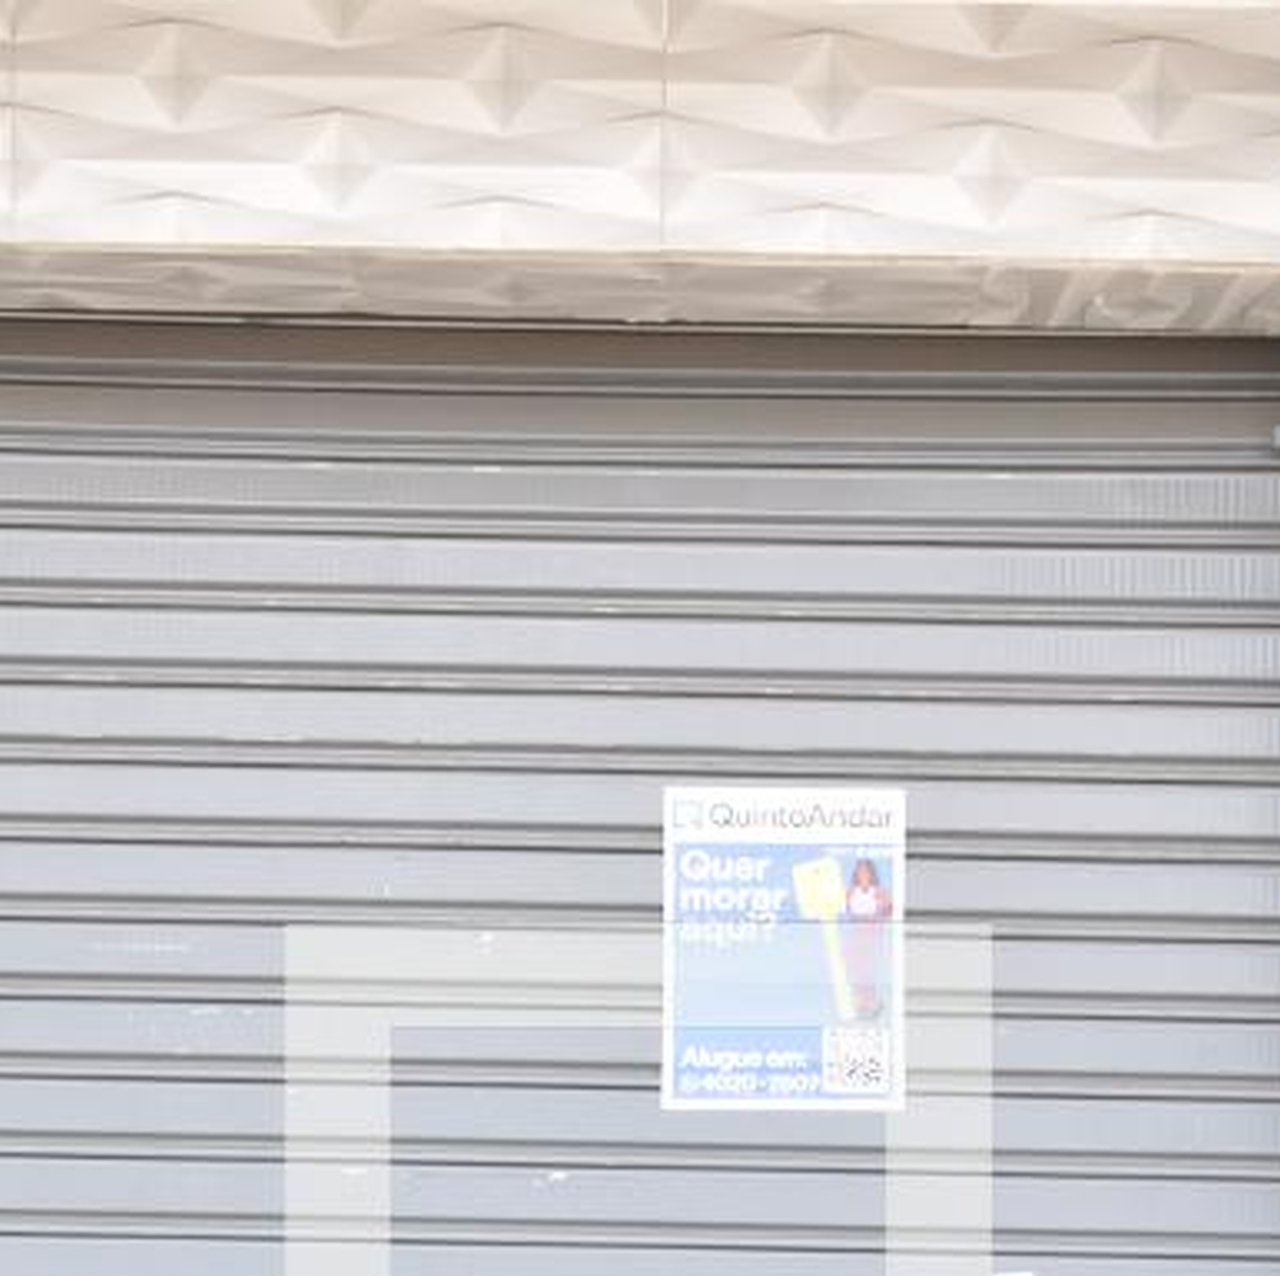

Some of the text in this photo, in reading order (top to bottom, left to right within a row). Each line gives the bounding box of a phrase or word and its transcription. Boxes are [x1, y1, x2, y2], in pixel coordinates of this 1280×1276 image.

[708, 802, 893, 829] QuintoAndar
[680, 849, 772, 882] Quer
[679, 886, 789, 911] morar
[678, 1044, 763, 1072] Alugue
